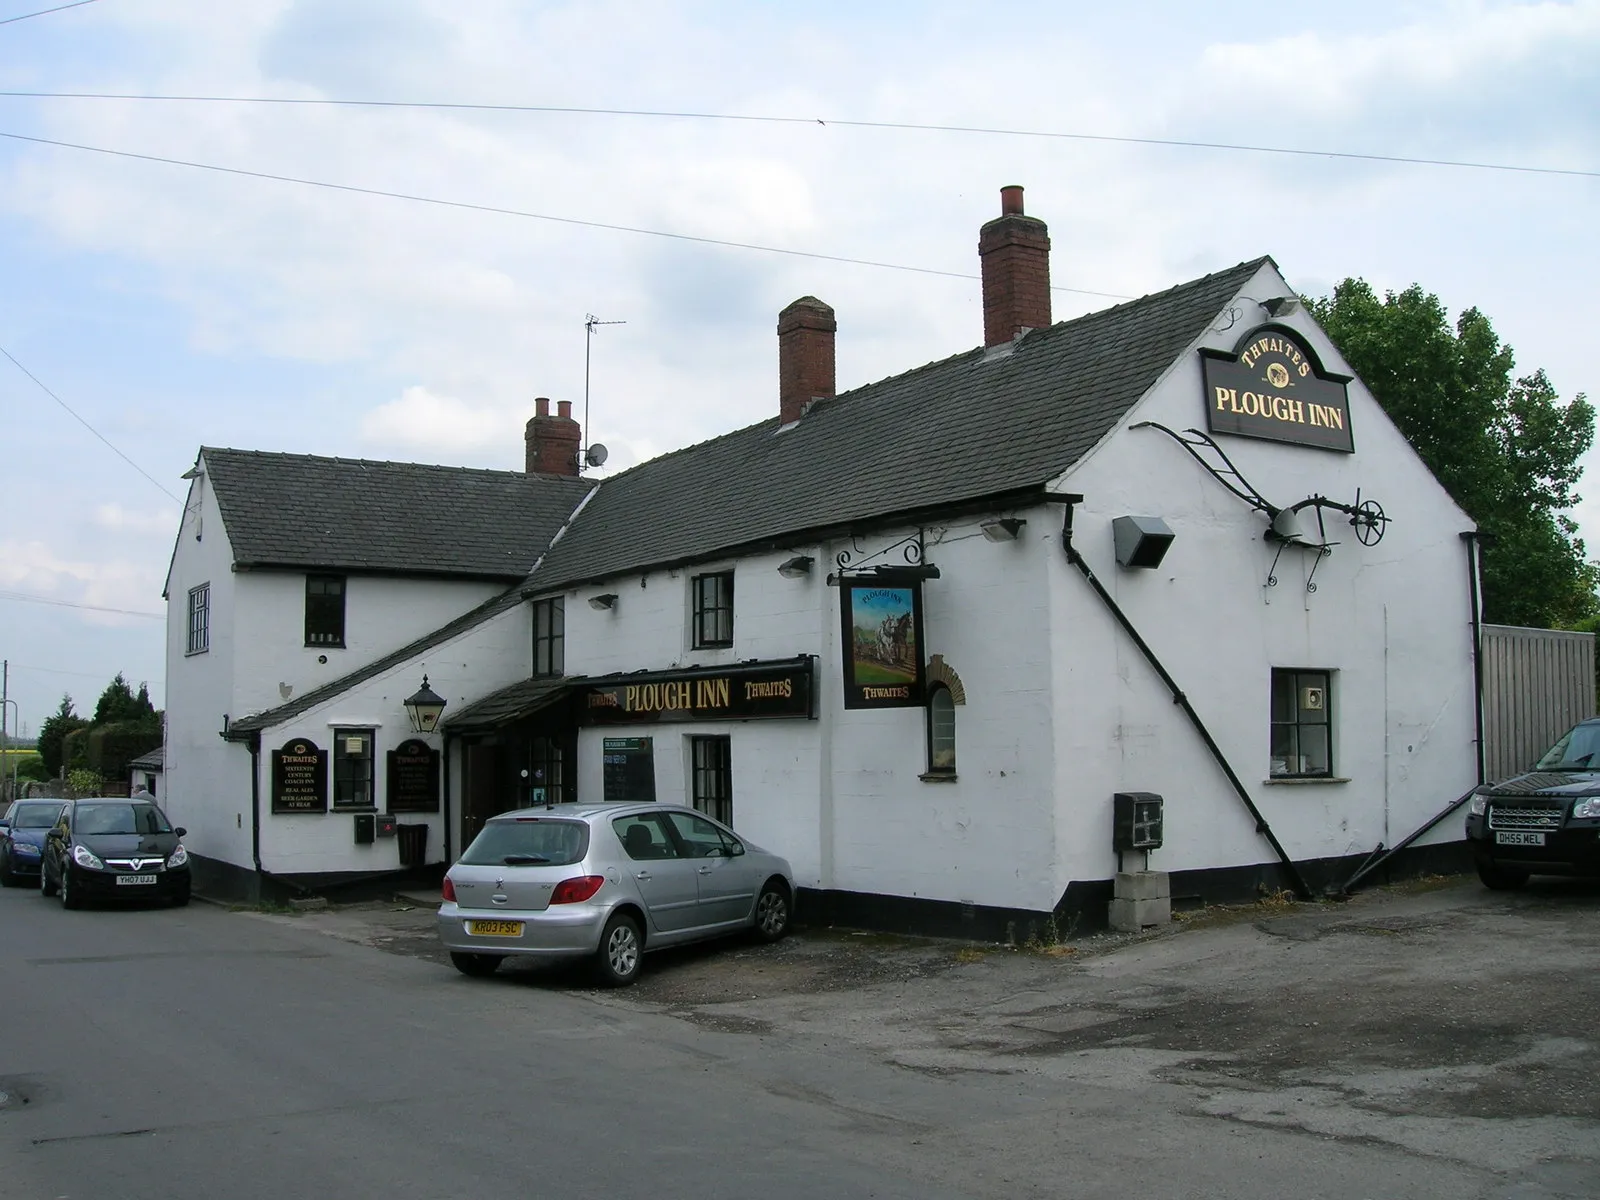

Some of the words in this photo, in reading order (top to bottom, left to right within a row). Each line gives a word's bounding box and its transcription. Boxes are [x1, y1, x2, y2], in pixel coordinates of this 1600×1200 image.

[1241, 338, 1310, 377] THWAITES
[1215, 387, 1305, 423] PLOUGH
[1308, 403, 1343, 430] INN
[862, 589, 889, 604] PLOUGH
[890, 591, 902, 604] INN
[587, 691, 618, 709] THWAITES
[625, 681, 692, 712] PLOUGH
[696, 678, 730, 709] INN
[745, 678, 792, 700] THWAITES
[863, 686, 909, 700] THWAITES
[281, 755, 318, 763] THWAITES
[1499, 833, 1521, 843] DH55
[1523, 834, 1541, 844] MEL
[474, 921, 497, 932] KR03
[498, 922, 517, 933] FSC
